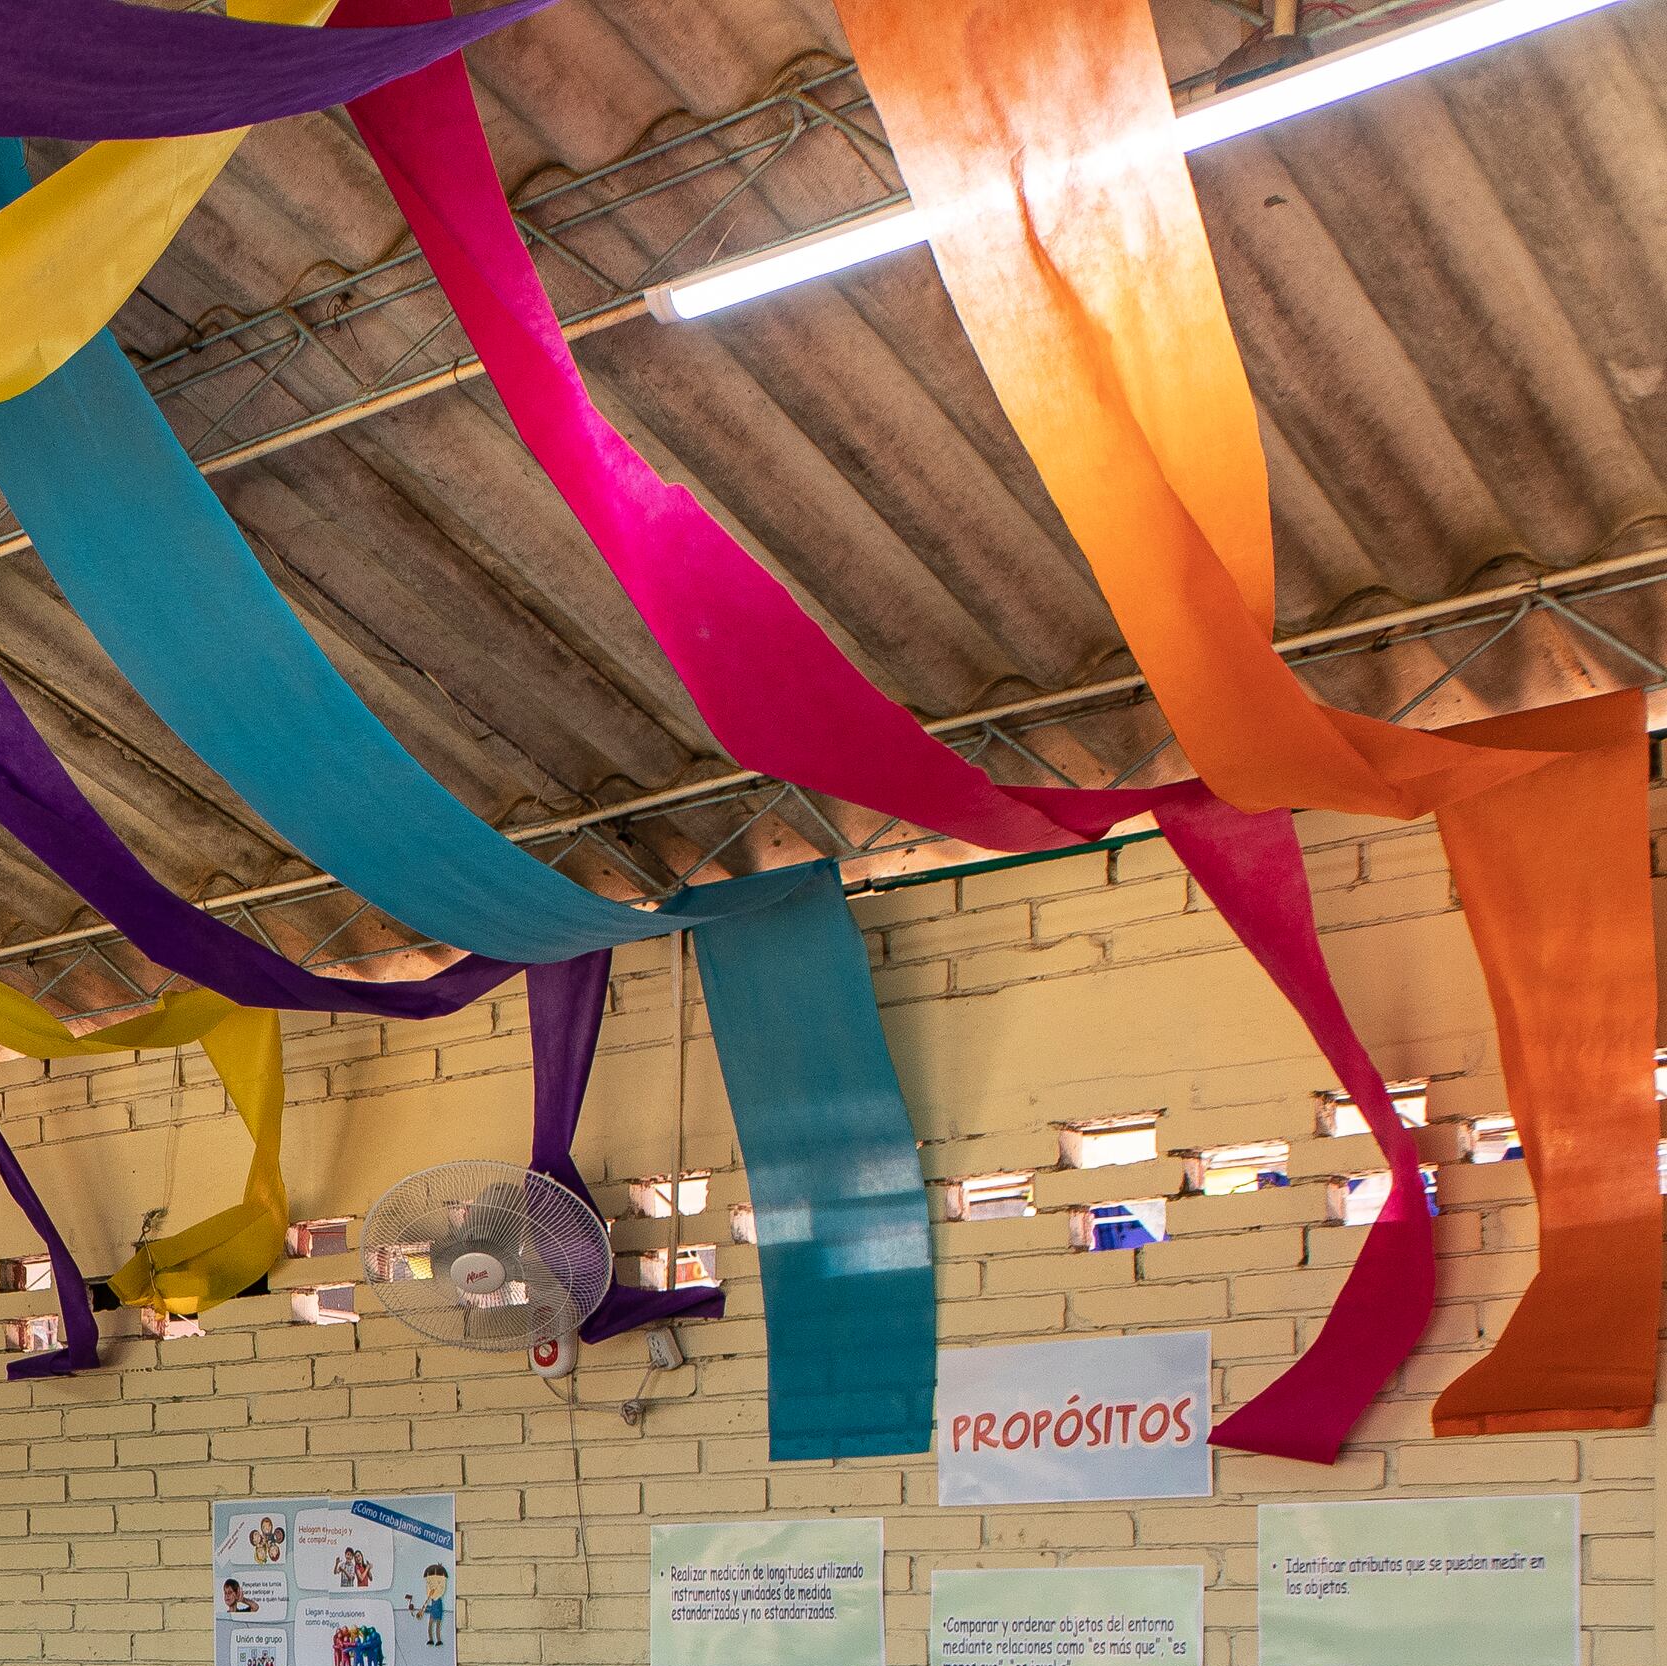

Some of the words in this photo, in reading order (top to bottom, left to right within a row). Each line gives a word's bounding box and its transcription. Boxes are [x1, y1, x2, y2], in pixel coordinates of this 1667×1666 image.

[951, 1394, 1192, 1453] PROPÓSITOS
[379, 1511, 423, 1535] trabajamos
[423, 1529, 452, 1546] mejor?
[670, 1566, 707, 1581] Realizar
[710, 1562, 751, 1581] medición
[752, 1564, 765, 1580] de
[766, 1563, 814, 1584] longitudes
[816, 1561, 864, 1579] utilizando
[1285, 1556, 1346, 1574] Identificar
[1349, 1555, 1403, 1573] atributos
[1405, 1557, 1426, 1576] que
[1445, 1553, 1489, 1575] pueden
[1491, 1552, 1527, 1570] medir
[671, 1586, 731, 1602] instrumentos
[741, 1584, 781, 1601] unidades
[783, 1584, 795, 1600] de
[797, 1583, 832, 1600] medida
[1304, 1579, 1350, 1600] objetos.
[671, 1605, 740, 1621] estandarizadas
[764, 1603, 837, 1620] estandarizadas.
[947, 1617, 999, 1637] Comparar
[1011, 1616, 1056, 1633] ordenar
[1059, 1615, 1103, 1637] objetos
[1107, 1615, 1125, 1632] del
[1128, 1618, 1175, 1633] entorno
[943, 1638, 993, 1655] mediante
[996, 1638, 1053, 1655] relaciones
[1056, 1641, 1085, 1655] como
[1109, 1637, 1132, 1655] más
